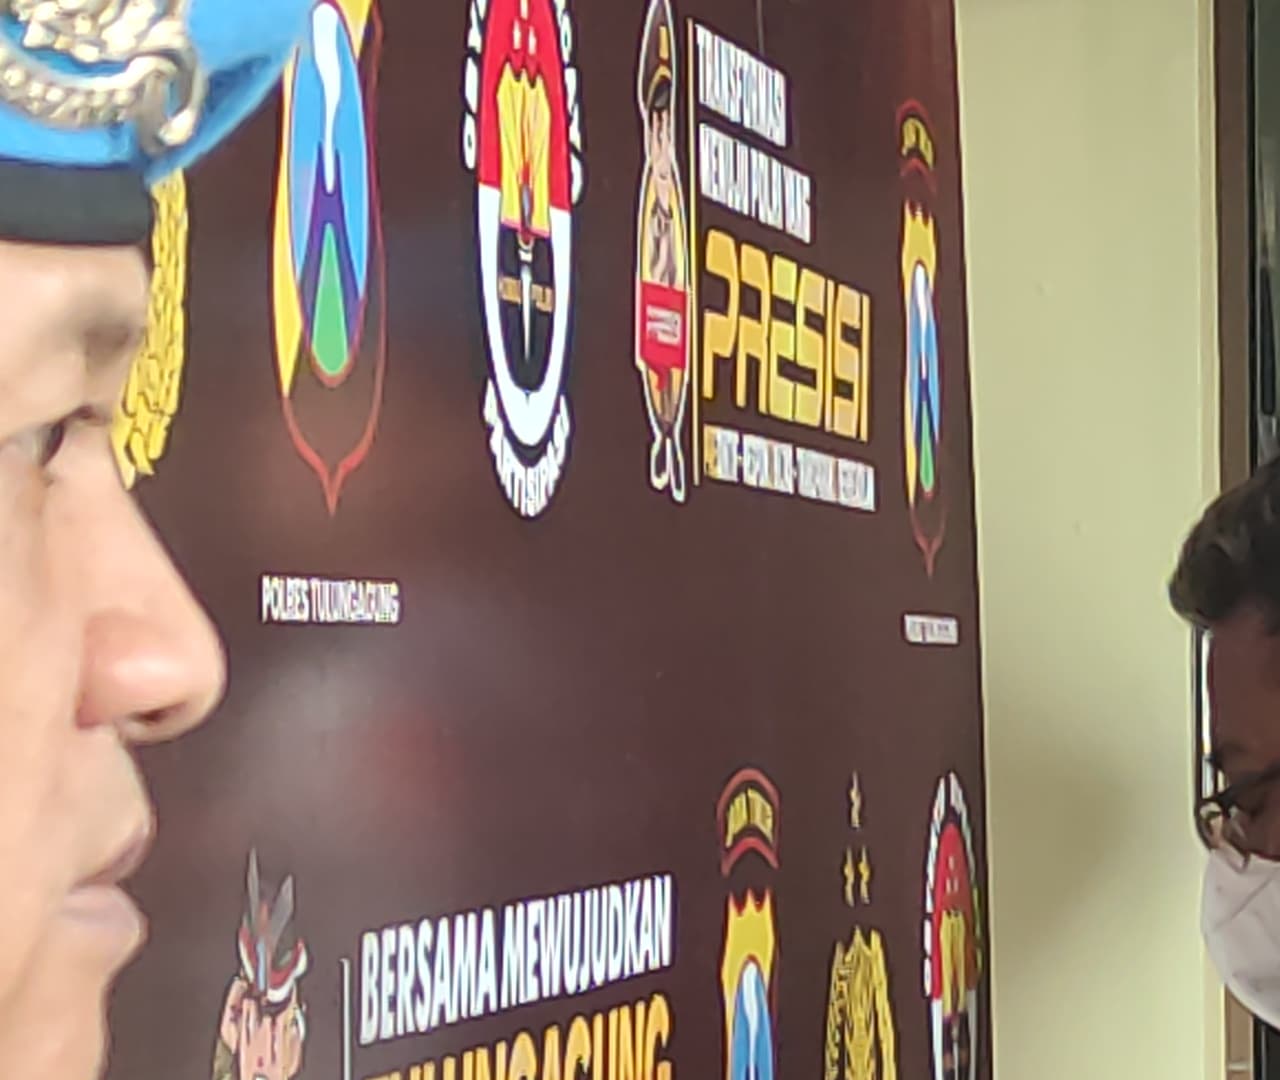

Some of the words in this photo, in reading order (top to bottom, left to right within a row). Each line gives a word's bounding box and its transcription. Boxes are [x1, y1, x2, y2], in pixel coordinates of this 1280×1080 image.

[702, 228, 871, 444] PRESISI
[262, 575, 309, 623] POLRES
[360, 908, 498, 1046] BERSAMA
[500, 874, 673, 1009] MEWUJUDKAN
